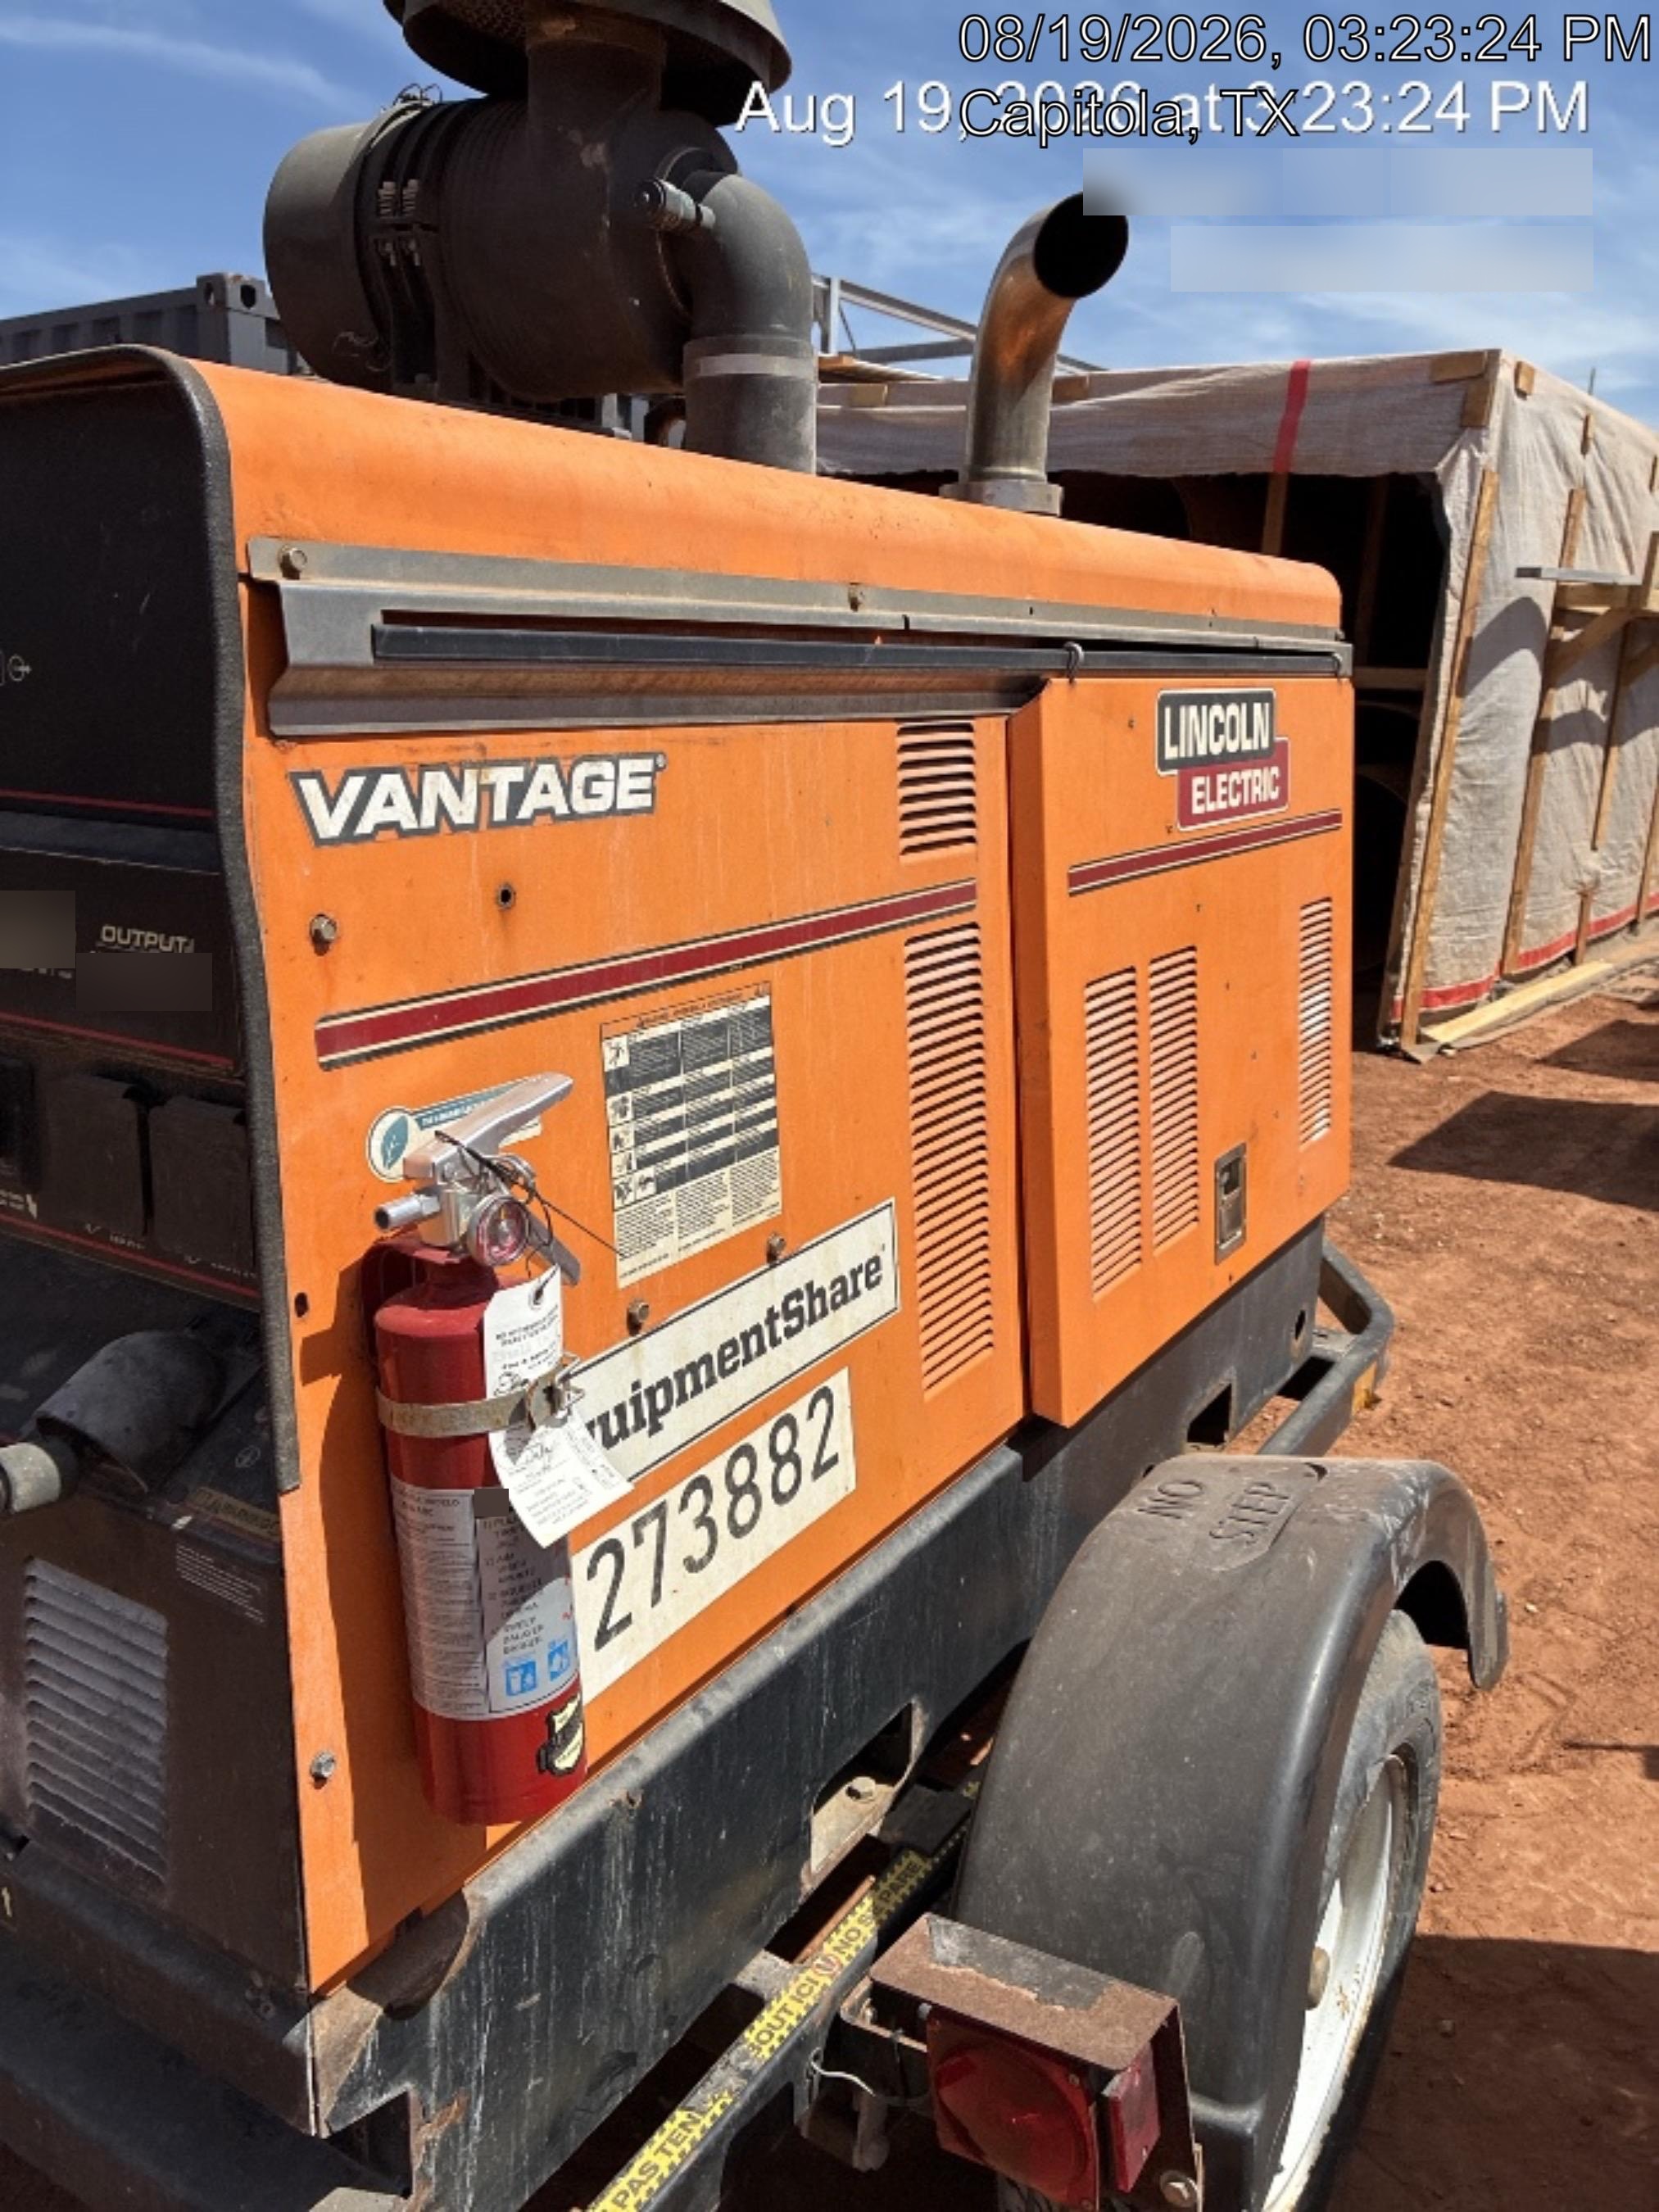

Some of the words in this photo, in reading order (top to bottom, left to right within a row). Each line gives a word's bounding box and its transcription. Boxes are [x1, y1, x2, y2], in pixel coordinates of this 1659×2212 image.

[1163, 701, 1271, 761] LINCOLN
[290, 754, 659, 845] VANTAGE
[1190, 765, 1281, 815] ELECTRIC
[101, 923, 189, 954] OUTPUT
[585, 1253, 884, 1450] uipmentShare
[586, 1385, 840, 1653] 273882
[1138, 1479, 1205, 1521] NO
[1208, 1481, 1292, 1545] STEP
[612, 2160, 660, 2210] PAS
